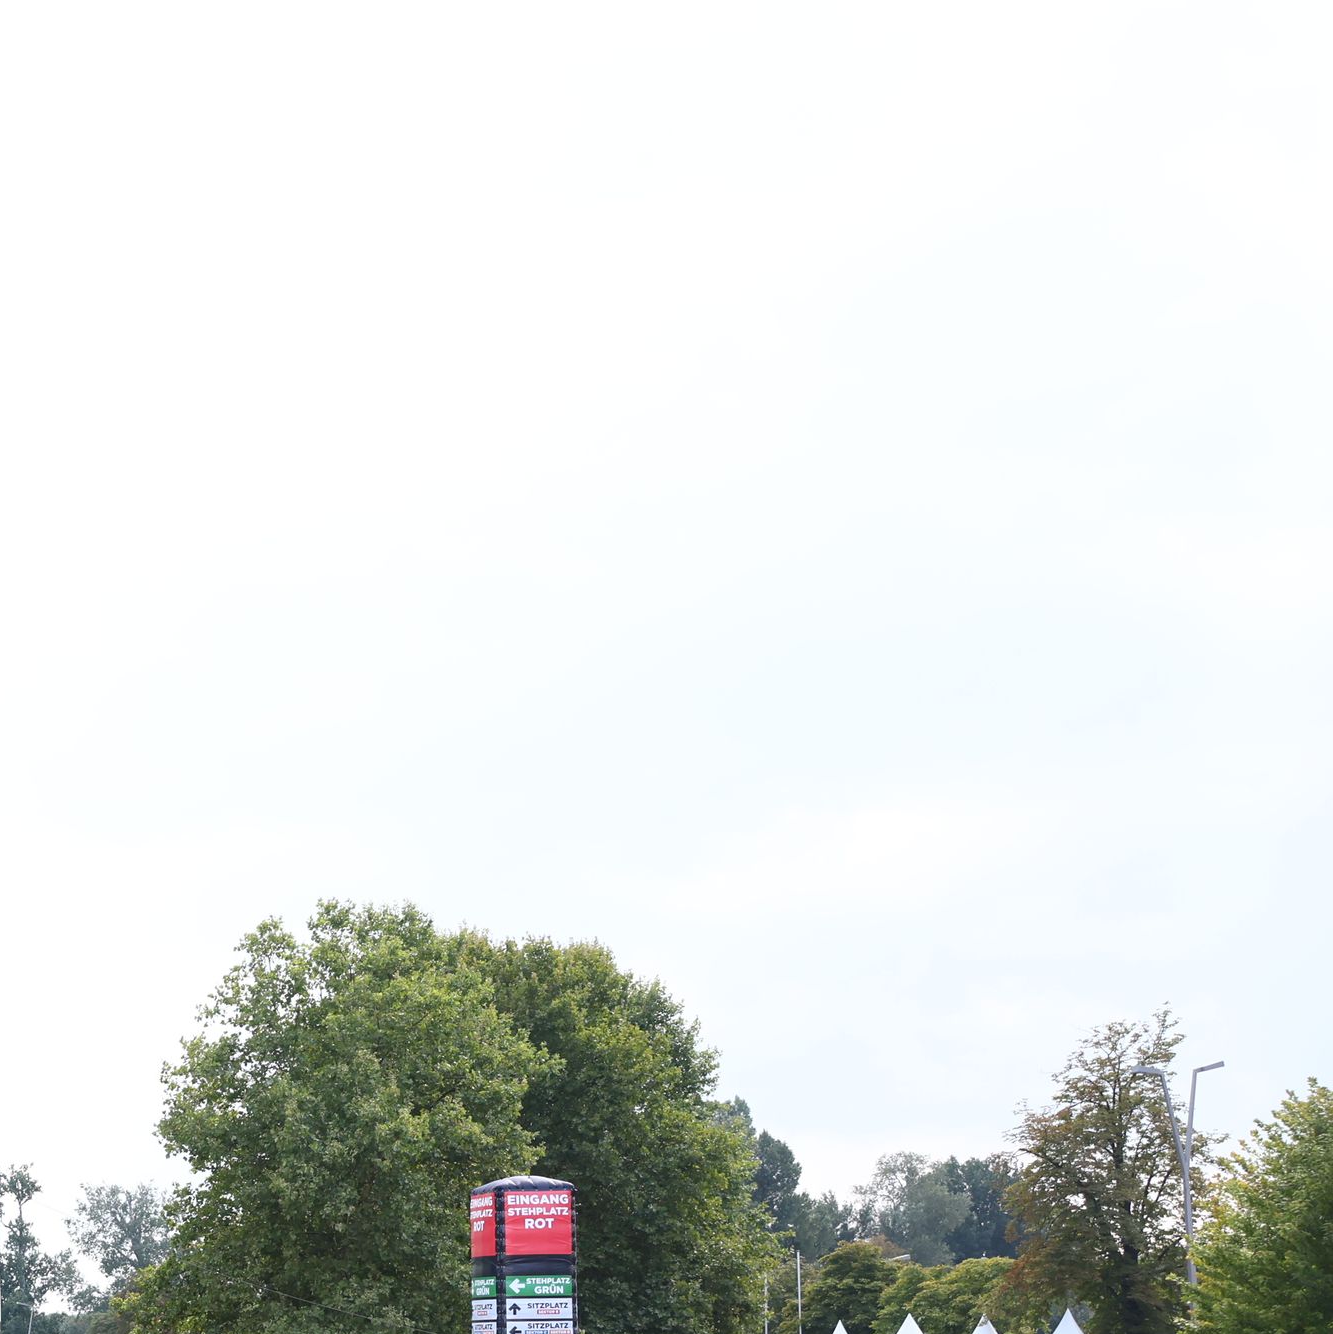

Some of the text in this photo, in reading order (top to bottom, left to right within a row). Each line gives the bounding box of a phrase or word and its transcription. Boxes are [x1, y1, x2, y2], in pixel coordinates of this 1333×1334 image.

[507, 1194, 569, 1205] EINGANG
[508, 1207, 569, 1216] STEHPLATZ
[525, 1218, 554, 1229] ROT
[526, 1277, 571, 1285] STEHPLATZ
[535, 1285, 564, 1294] GRÜN
